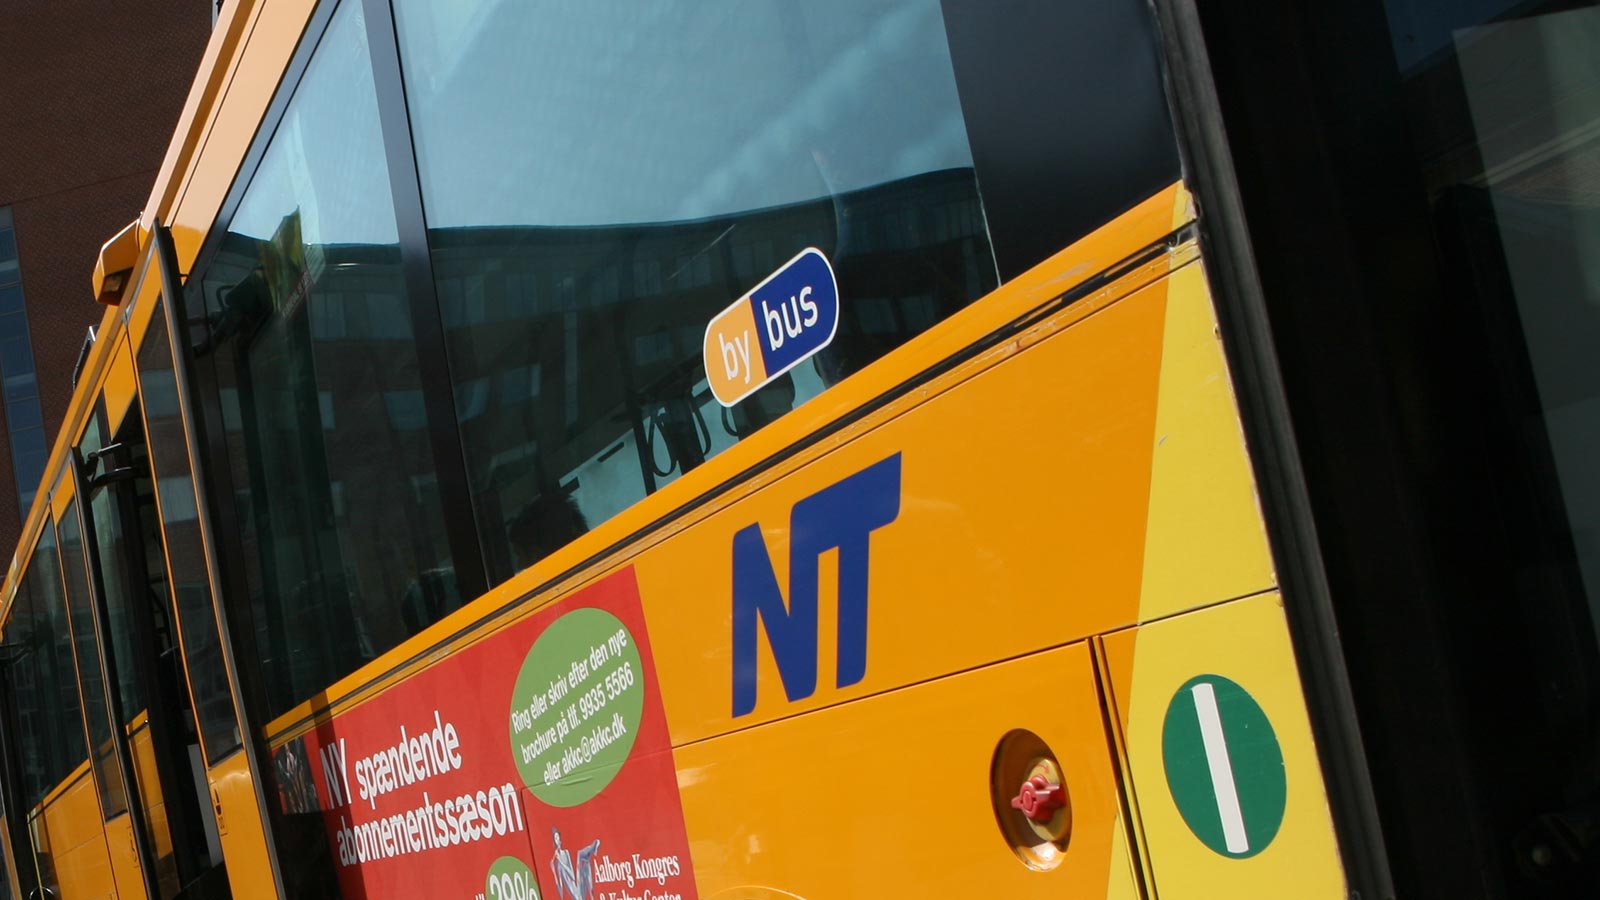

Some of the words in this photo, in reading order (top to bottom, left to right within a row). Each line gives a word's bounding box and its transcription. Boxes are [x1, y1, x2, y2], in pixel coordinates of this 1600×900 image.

[718, 331, 751, 385] by
[761, 286, 819, 351] bus
[732, 450, 902, 719] NT
[511, 710, 532, 734] Ring
[530, 694, 548, 720] eller
[548, 673, 569, 706] skriv
[568, 661, 590, 688] efter
[590, 645, 610, 671] den
[608, 629, 628, 656] nye
[520, 732, 558, 764] brochure
[556, 711, 570, 744] på
[579, 682, 607, 720] 9935
[605, 662, 634, 700] 5566
[319, 738, 352, 809] NY
[355, 710, 462, 810] spændende
[543, 761, 562, 786] eller
[561, 712, 628, 775] akkc@akkc.dk
[336, 782, 524, 868] abonnementssæson
[593, 855, 635, 888] Aalborg
[631, 853, 680, 886] Kongres
